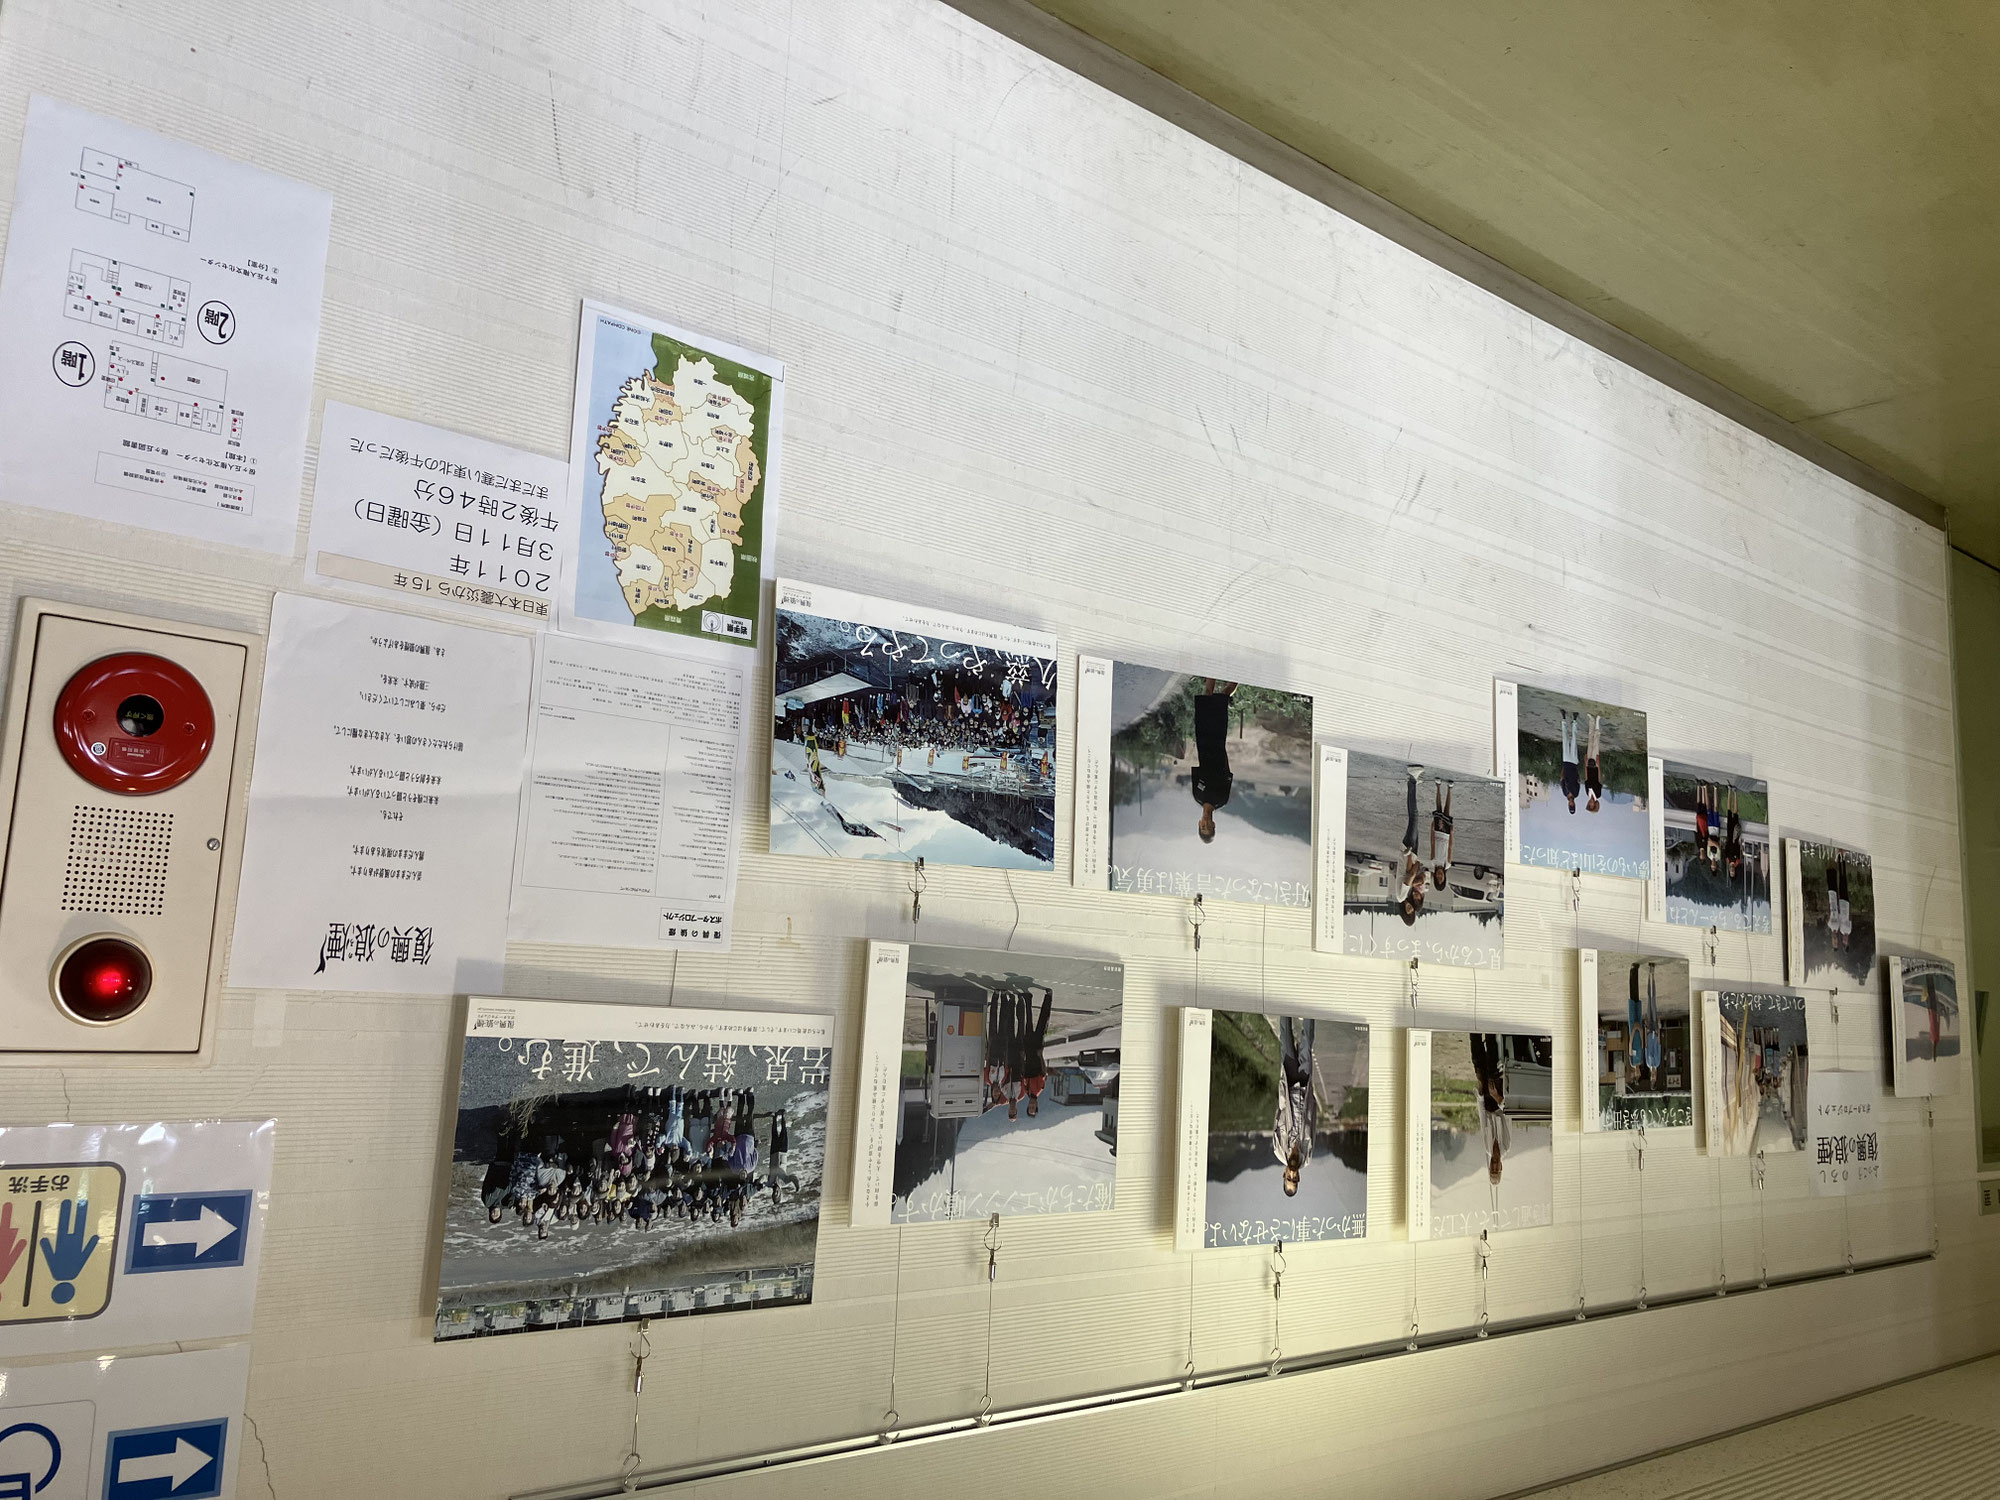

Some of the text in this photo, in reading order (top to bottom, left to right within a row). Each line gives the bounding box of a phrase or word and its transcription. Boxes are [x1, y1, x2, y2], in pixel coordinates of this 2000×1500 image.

[204, 308, 229, 339] 2階
[60, 350, 87, 380] 1階
[350, 437, 549, 500] まだまだ寒い東北の午後だった
[413, 478, 559, 532] 午後2時46分
[393, 572, 408, 588] 年
[412, 576, 432, 592] 15
[449, 554, 550, 592] 2011年
[726, 624, 748, 635] 岩手県
[838, 620, 1056, 690] 久慈、やってやる。
[380, 810, 404, 822] それでも、
[1108, 864, 1310, 908] 好きになった言葉は勇気。
[663, 912, 722, 924] ポスタープロジェクト
[324, 922, 434, 967] 復興の狼煙
[1343, 932, 1500, 970] 見てるから、まっすぐに。
[498, 1036, 829, 1084] 岩泉、結んで、進む。
[1817, 1132, 1878, 1165] 復興の狼煙
[8, 1175, 70, 1194] お手洗
